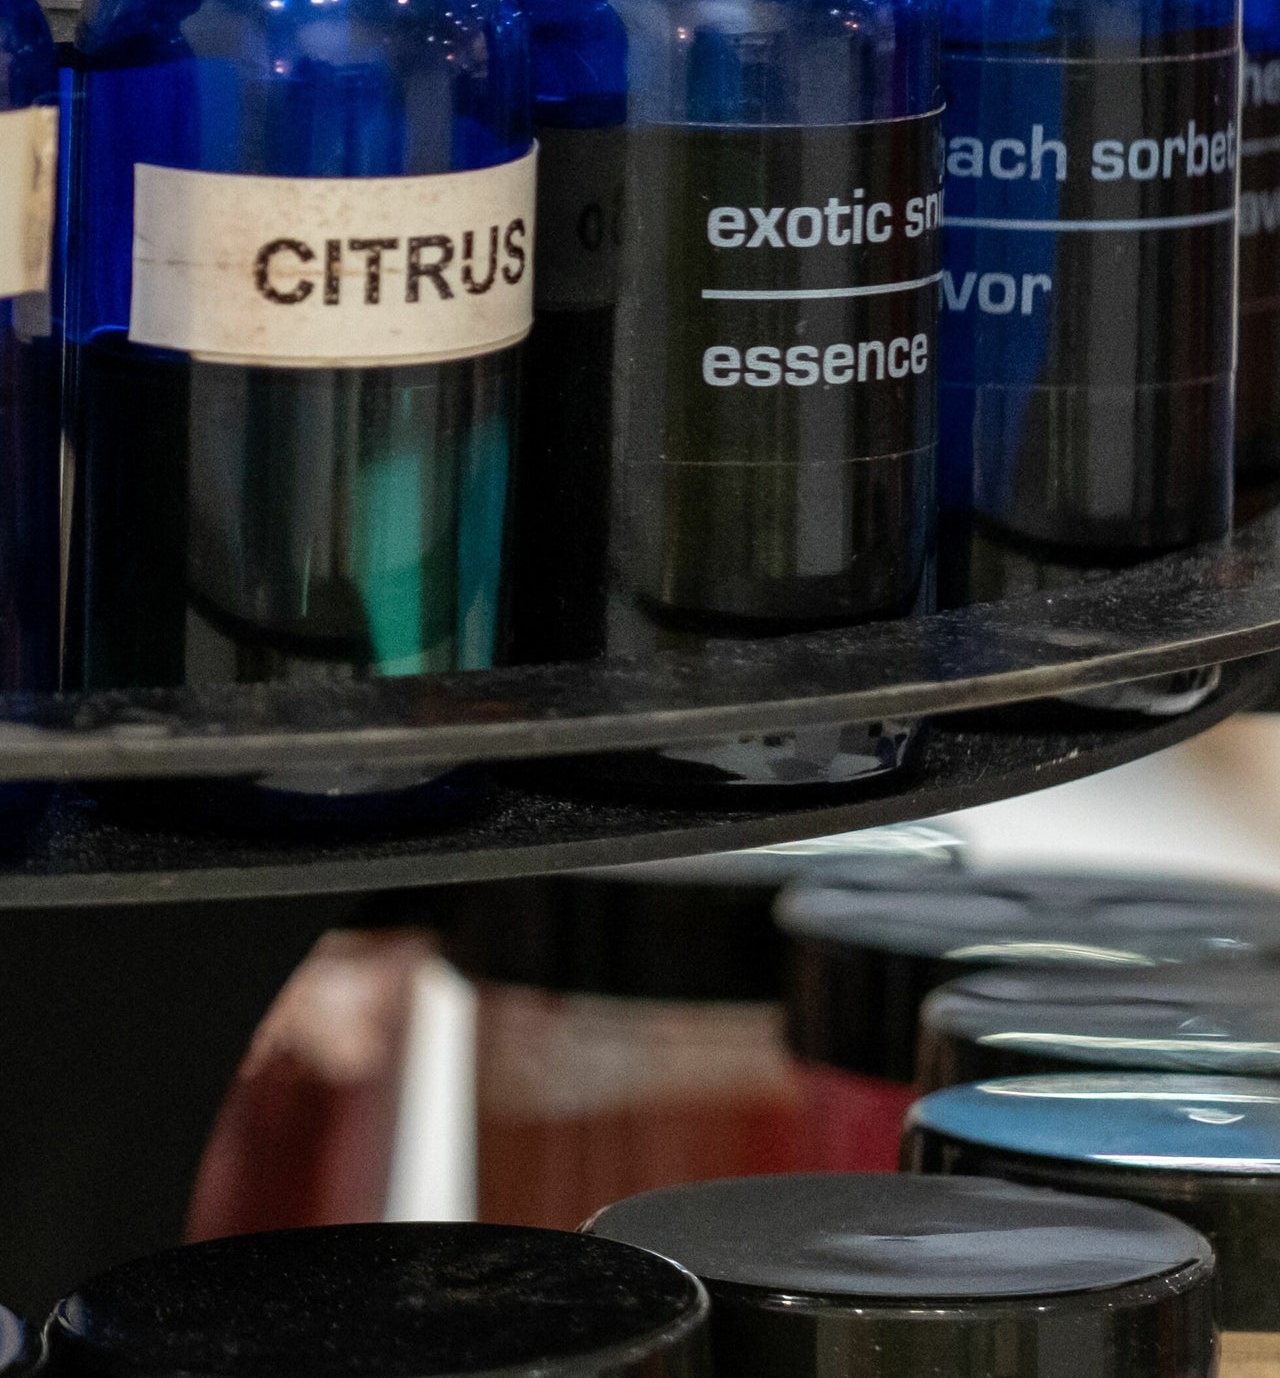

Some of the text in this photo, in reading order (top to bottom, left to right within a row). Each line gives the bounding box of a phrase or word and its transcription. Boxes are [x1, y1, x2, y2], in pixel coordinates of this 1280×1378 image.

[945, 119, 1236, 182] ach sorbet
[706, 187, 893, 248] exotic
[252, 217, 527, 306] CITRUS
[702, 332, 929, 388] essence
